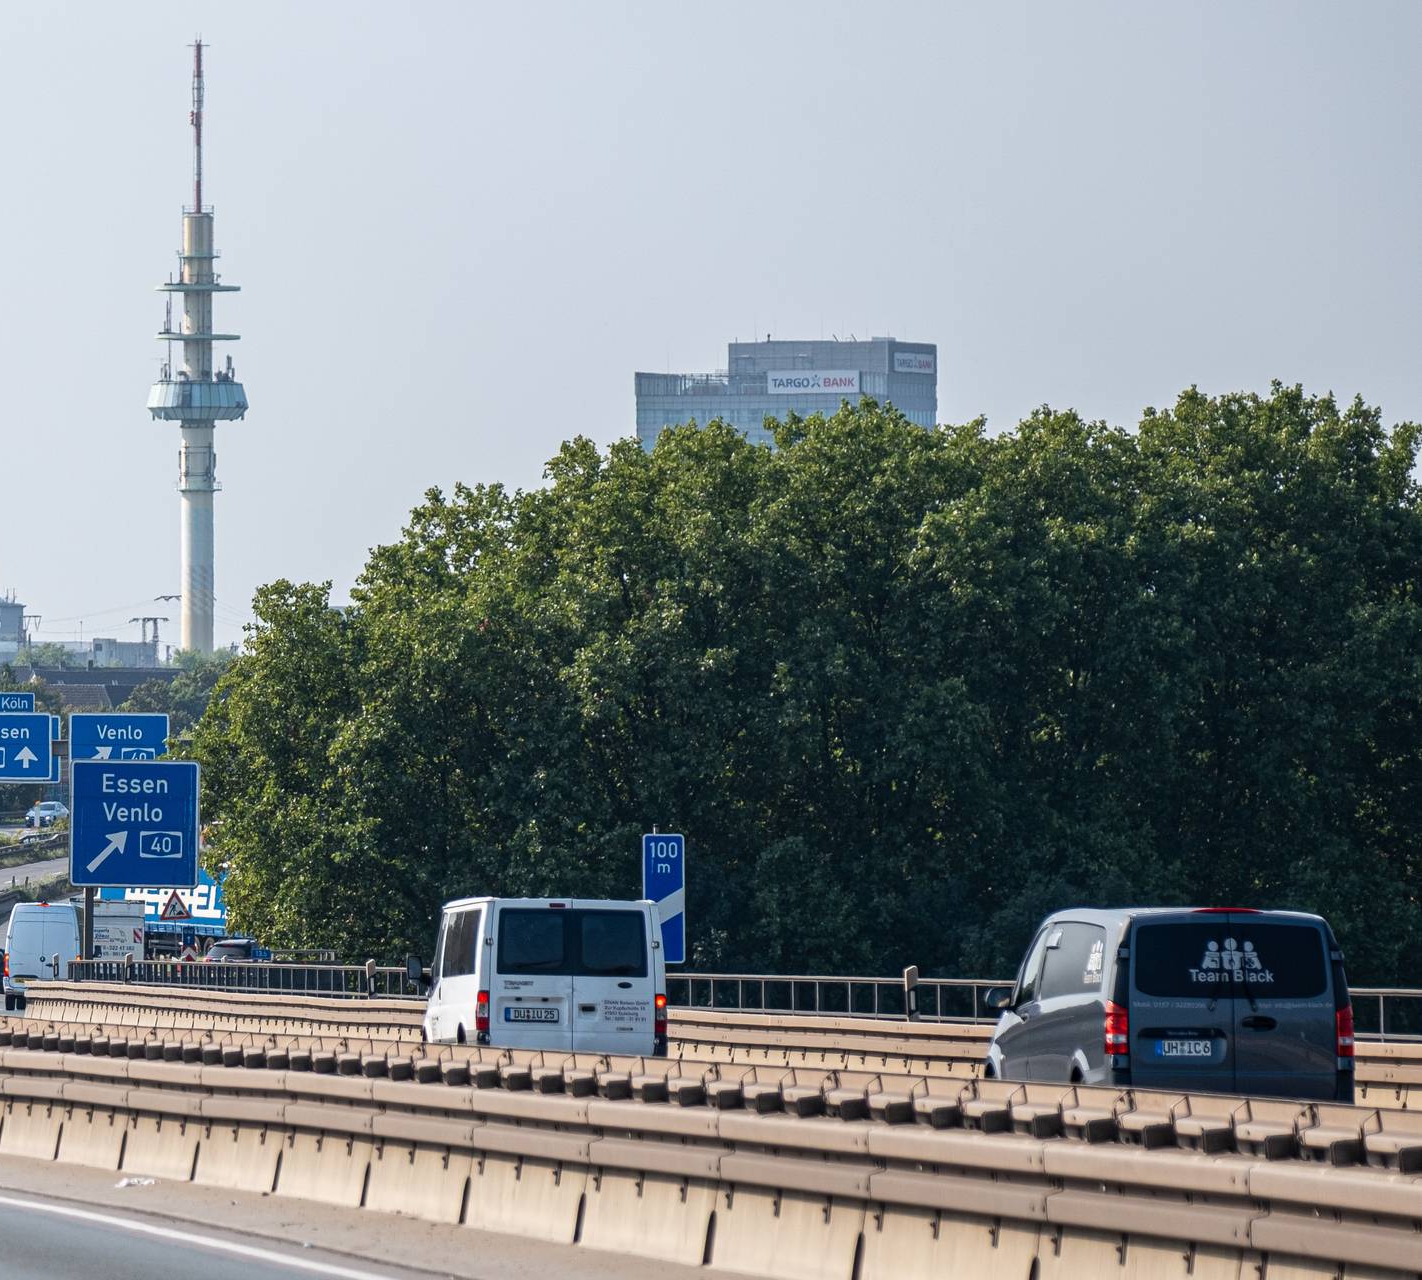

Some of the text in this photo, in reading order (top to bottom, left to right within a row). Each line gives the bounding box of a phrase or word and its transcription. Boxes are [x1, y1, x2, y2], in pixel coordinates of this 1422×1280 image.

[771, 376, 855, 389] TARGO BANK
[1, 696, 28, 709] Köln
[96, 724, 143, 740] Venlo
[102, 773, 168, 794] Essen
[102, 802, 163, 822] Venlo
[150, 836, 172, 853] 40
[649, 841, 678, 858] 100
[657, 863, 671, 873] m
[1189, 968, 1275, 983] Team Black
[513, 1009, 555, 1020] DU IU 25
[1203, 1042, 1210, 1054] 6
